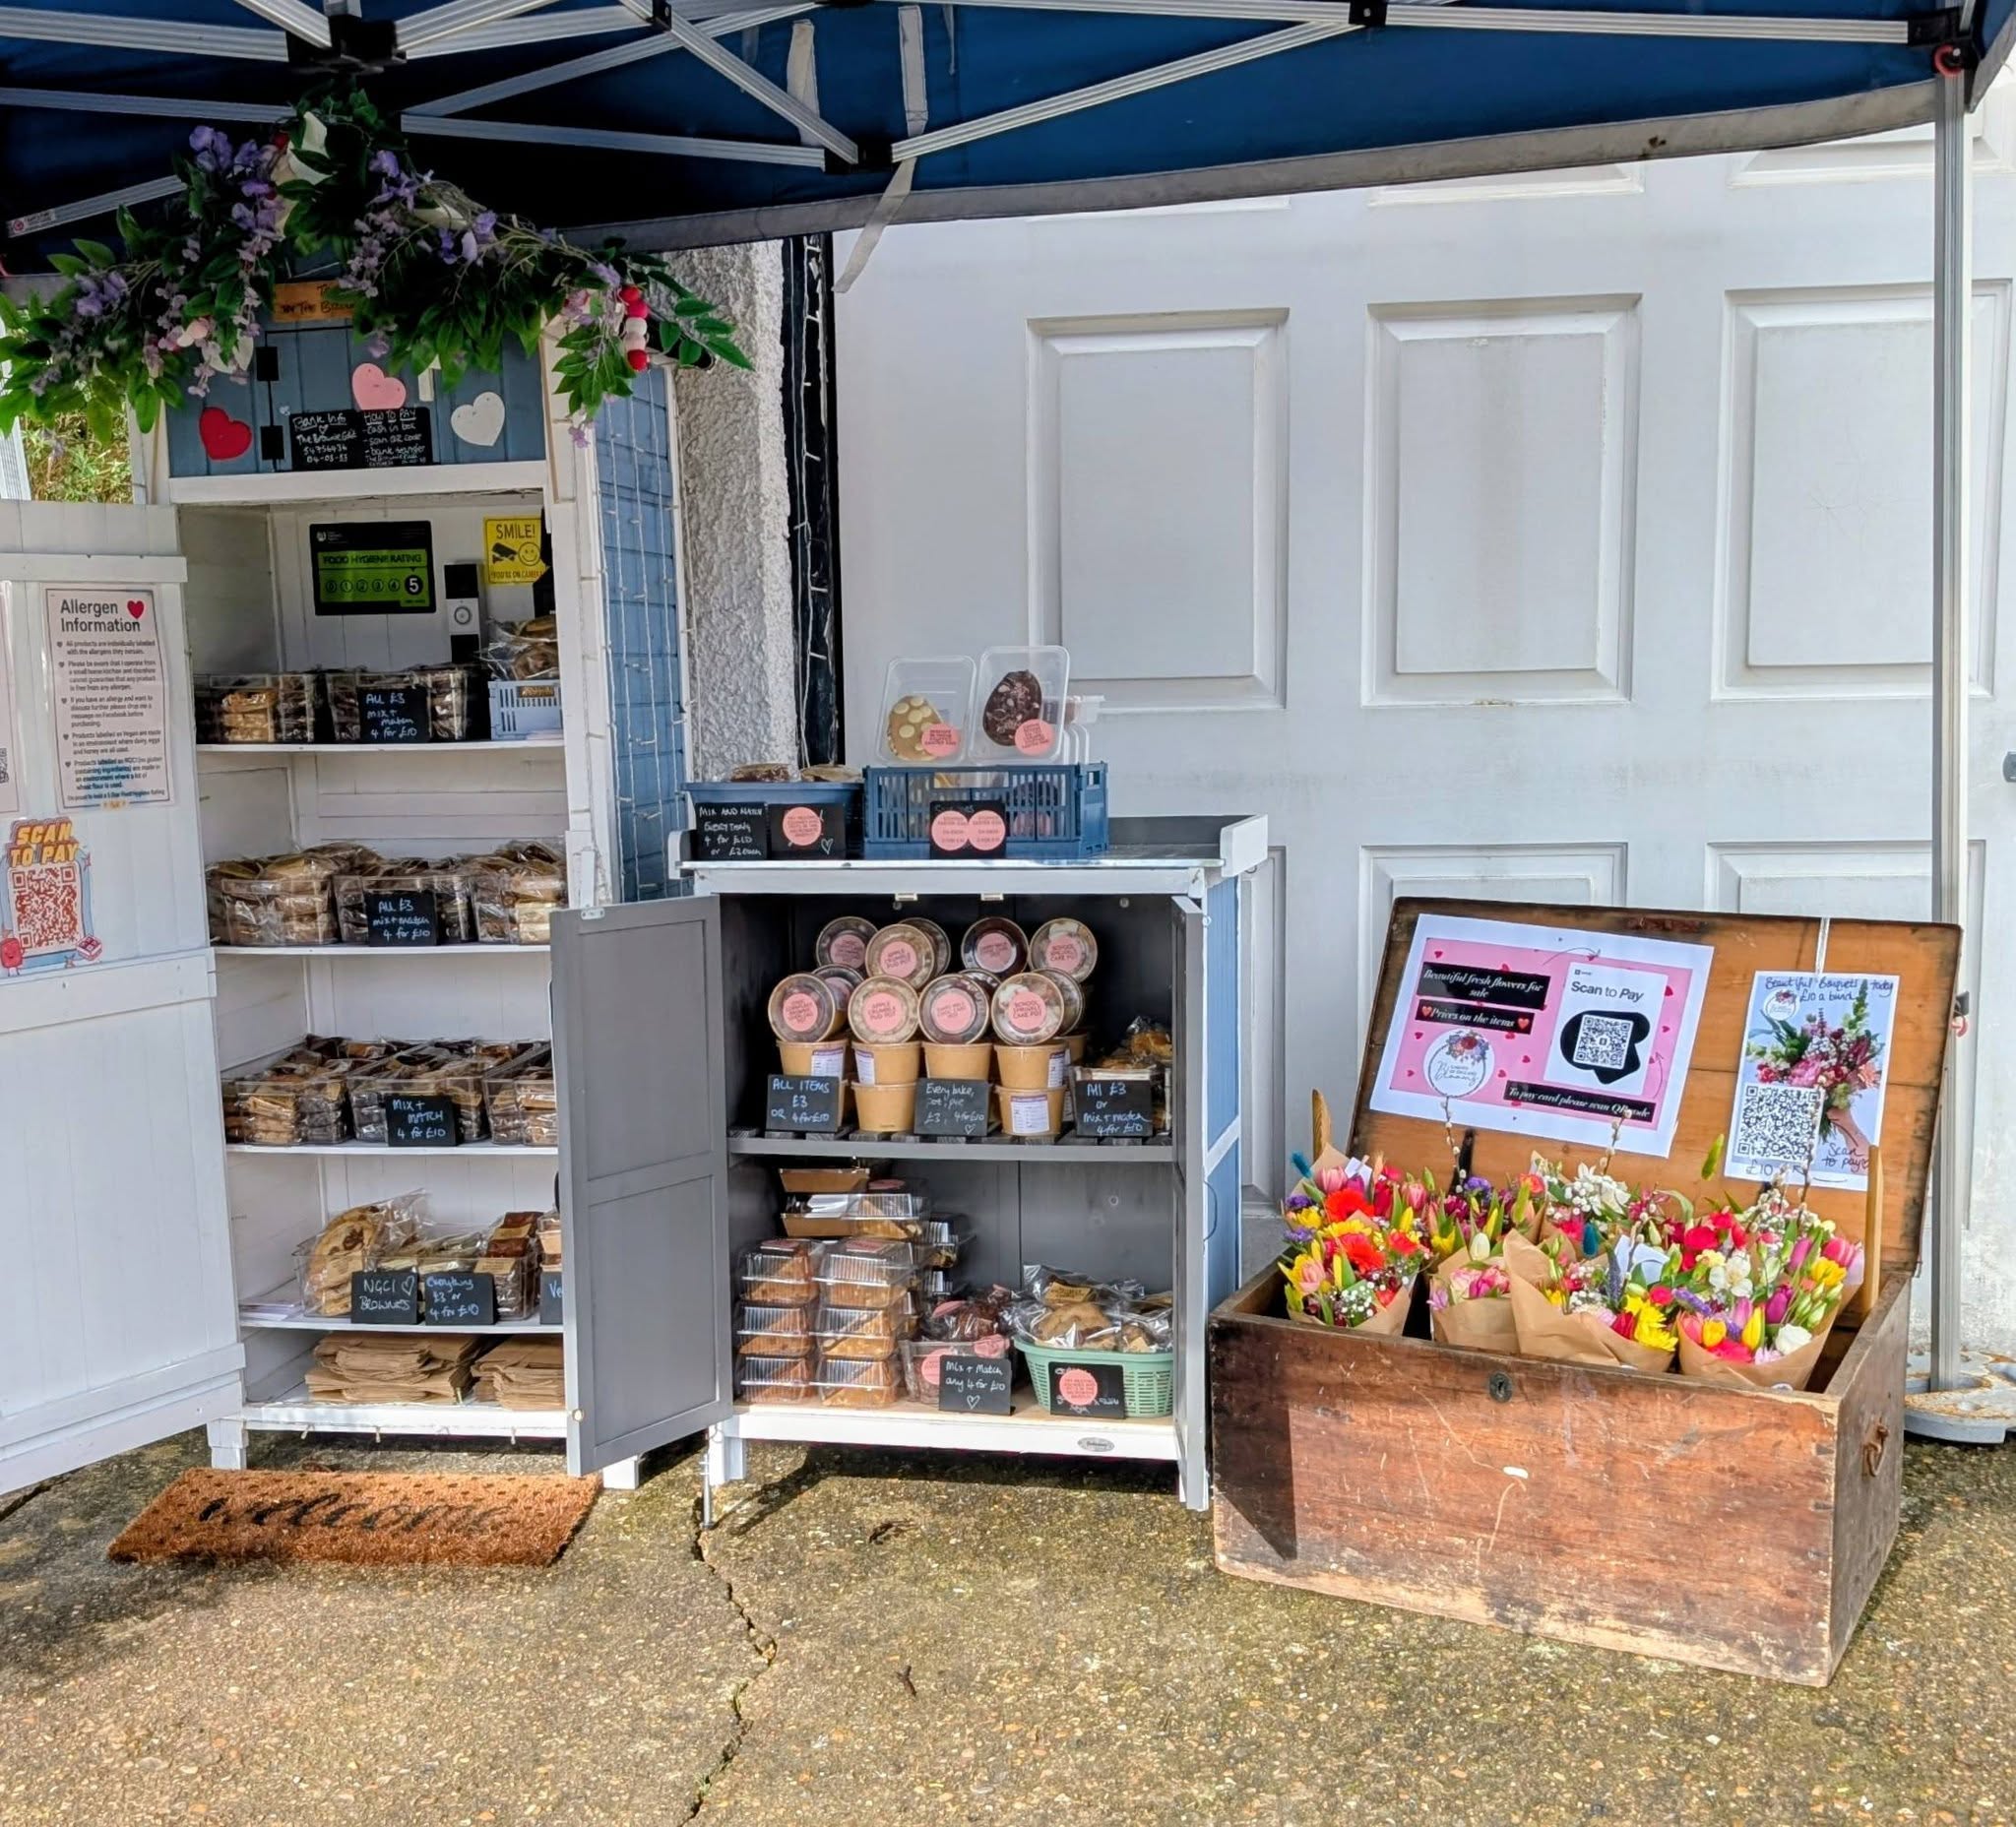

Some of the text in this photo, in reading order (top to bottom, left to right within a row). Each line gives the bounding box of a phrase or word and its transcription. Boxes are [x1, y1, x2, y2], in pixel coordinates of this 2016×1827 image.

[496, 524, 536, 539] SMILE!
[323, 553, 422, 564] FOOD HYGIENE RATING
[409, 577, 419, 594] 5
[60, 598, 119, 618] Allergen
[61, 617, 141, 633] Information
[370, 728, 379, 739] 4
[17, 823, 72, 845] SCAN
[10, 843, 79, 868] TO PAY
[396, 926, 410, 939] for
[1423, 969, 1544, 993] Beautiful fresh flowers for
[1765, 976, 1813, 989] Beautiful
[1469, 988, 1489, 998] sale
[1571, 980, 1644, 1003] Scan to Pay
[1799, 989, 1816, 1002] £10
[1430, 1008, 1457, 1020] Prices
[1473, 1013, 1488, 1023] the
[1490, 1016, 1515, 1027] items
[772, 1078, 830, 1094] ALL ITEMS
[926, 1083, 950, 1099] Every
[1109, 1082, 1127, 1096] £3
[1096, 1101, 1108, 1109] or
[1508, 1087, 1520, 1097] To
[1519, 1091, 1537, 1101] pay
[1538, 1093, 1559, 1102] card
[1557, 1095, 1588, 1107] please
[1588, 1102, 1609, 1111] scan
[408, 1110, 443, 1123] MATCH
[771, 1108, 787, 1119] OR
[397, 1128, 405, 1139] 4
[426, 1127, 446, 1139] £10
[1828, 1143, 1864, 1157] Scan
[1745, 1159, 1773, 1176] £10
[1821, 1156, 1836, 1167] to
[364, 1279, 396, 1294] NGCI
[549, 1282, 563, 1298] Ve
[429, 1303, 479, 1320] 4 for £10
[976, 1363, 1003, 1375] Match
[945, 1377, 1005, 1393] any 4 for £10
